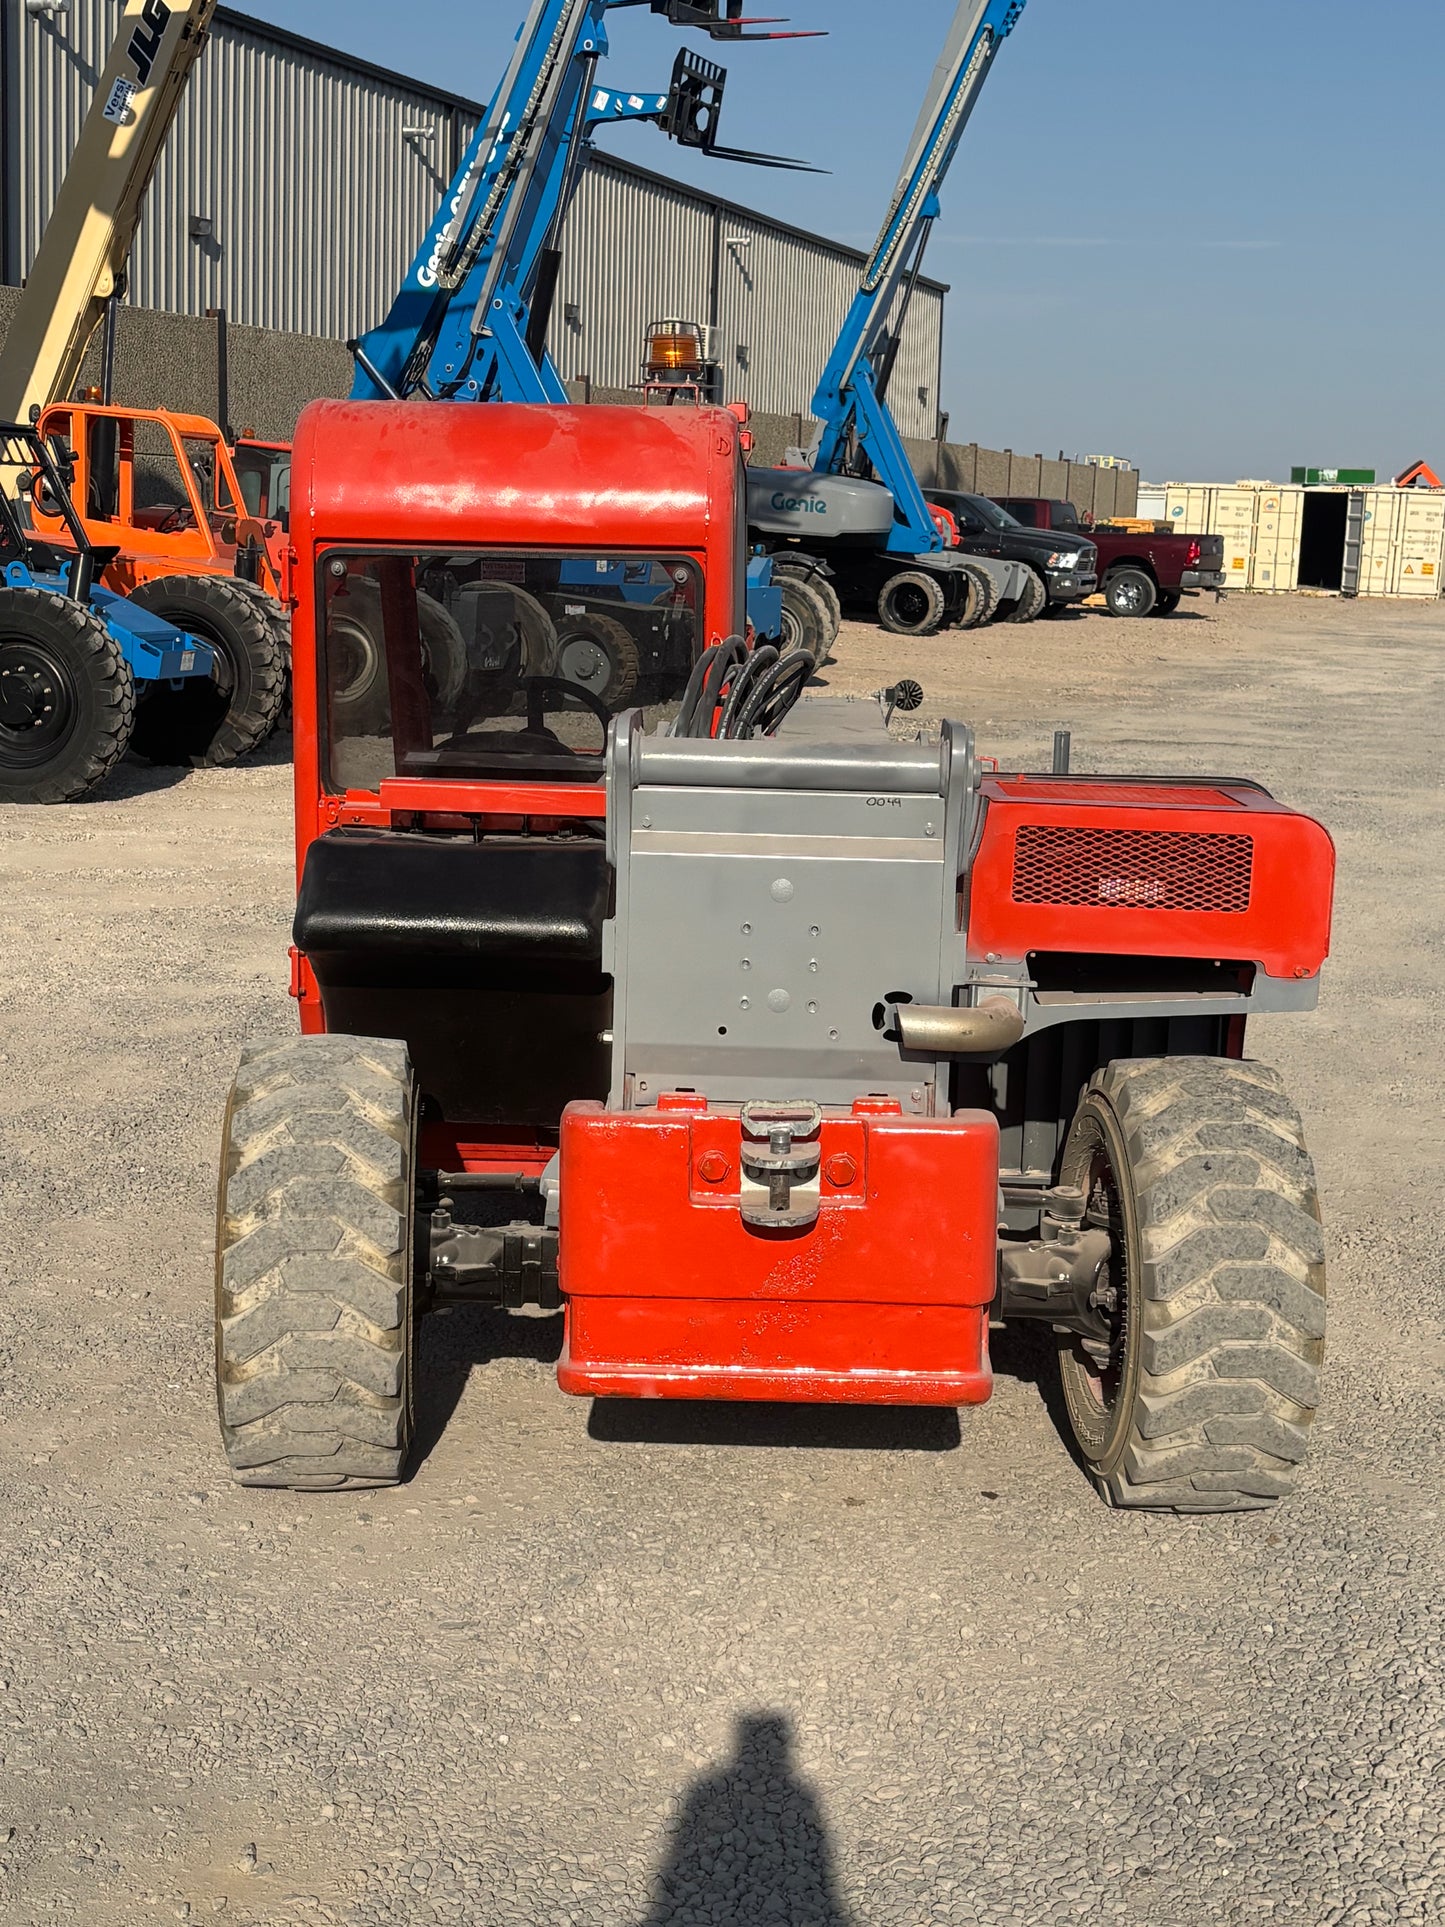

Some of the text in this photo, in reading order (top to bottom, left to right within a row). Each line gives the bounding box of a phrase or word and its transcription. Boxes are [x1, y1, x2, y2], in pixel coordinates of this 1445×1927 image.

[127, 0, 172, 88] JLG
[104, 78, 126, 116] Versi
[771, 492, 827, 514] Genie
[866, 797, 902, 807] 0049
